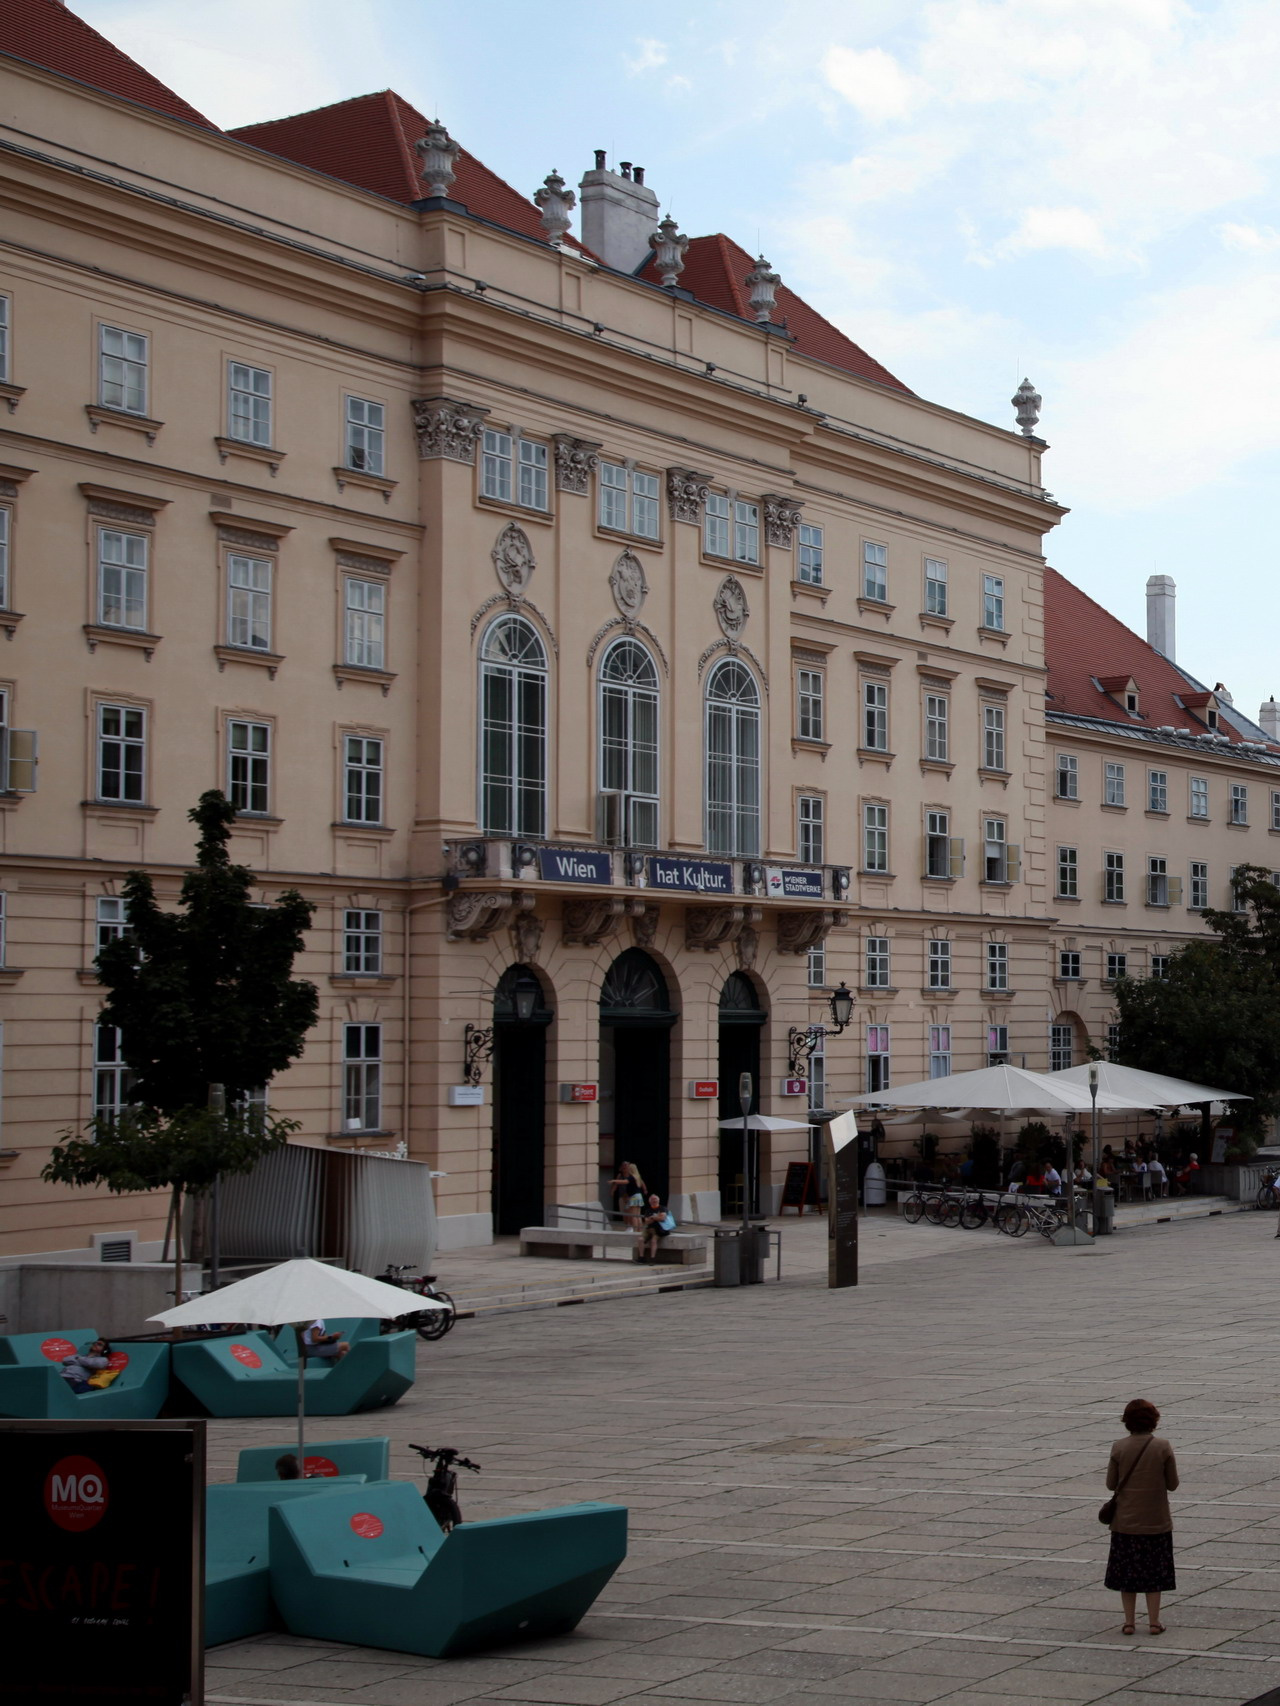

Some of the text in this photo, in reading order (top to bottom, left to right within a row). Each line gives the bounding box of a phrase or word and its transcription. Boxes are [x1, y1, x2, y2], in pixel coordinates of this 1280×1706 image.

[556, 856, 597, 878] Wien
[656, 863, 727, 890] hat Kultur.
[785, 884, 821, 894] STADTWERKE
[51, 1474, 105, 1503] MQ
